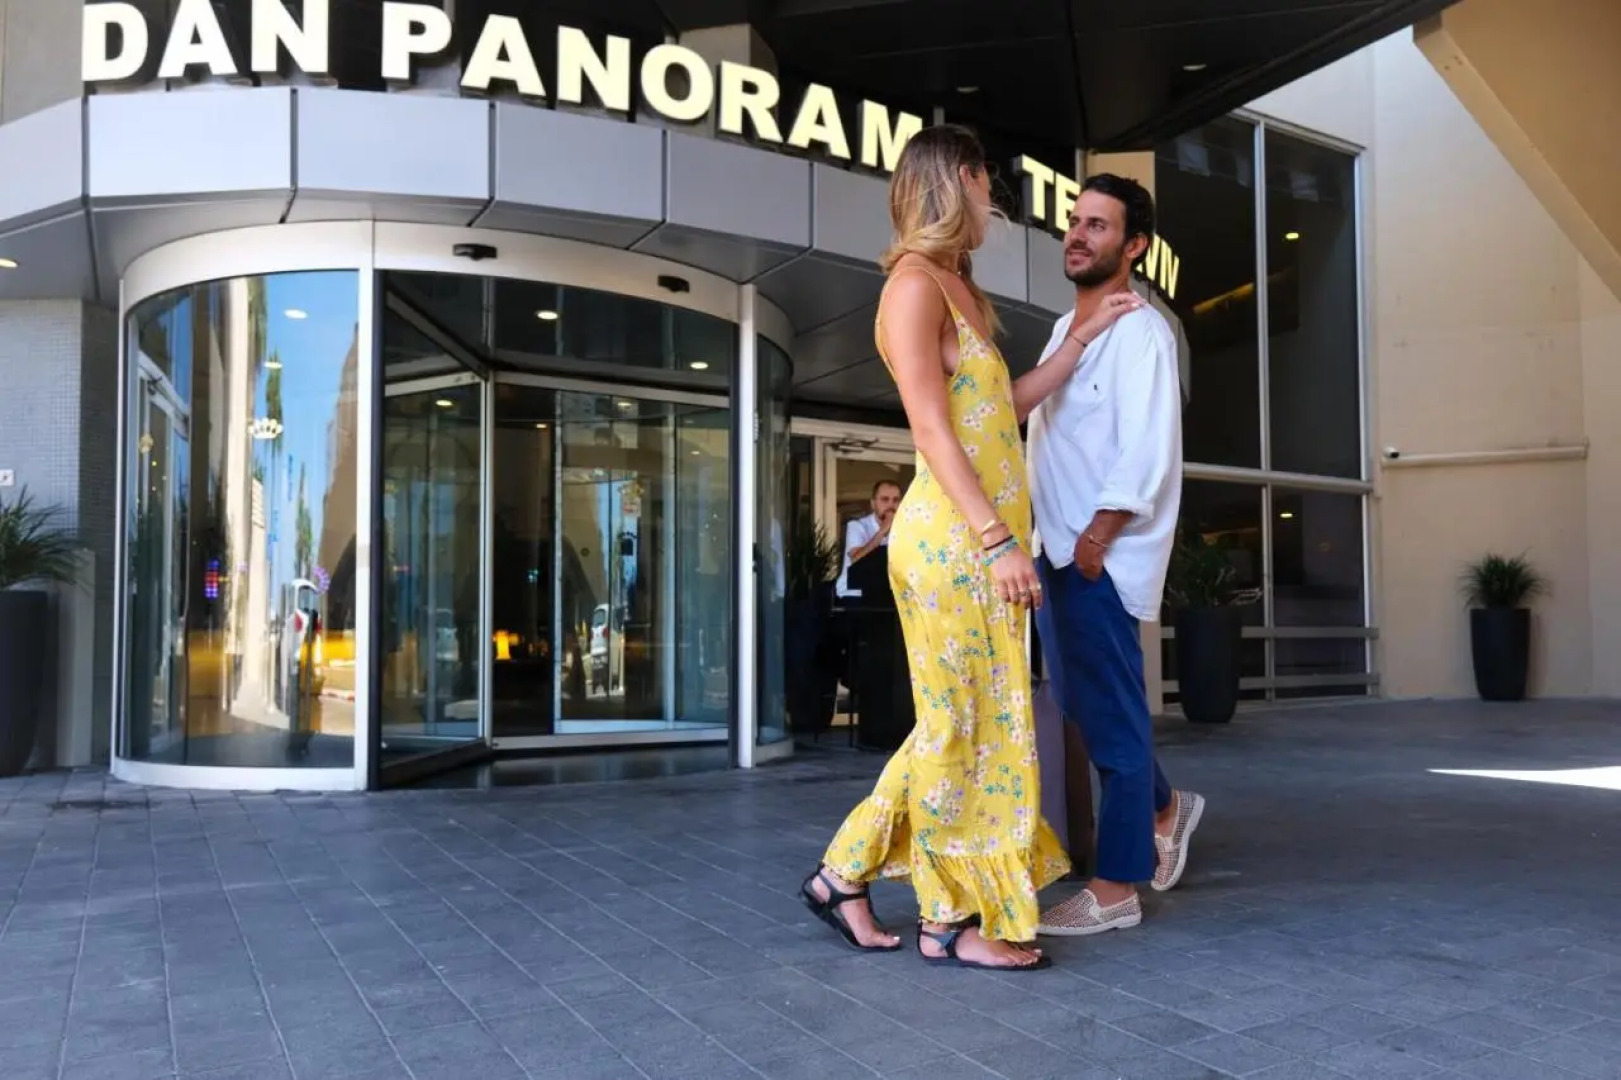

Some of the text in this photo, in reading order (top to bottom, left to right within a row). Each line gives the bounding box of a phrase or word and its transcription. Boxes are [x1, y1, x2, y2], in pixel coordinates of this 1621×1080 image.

[81, 0, 1180, 300] DAN PANORAM TE VIV
